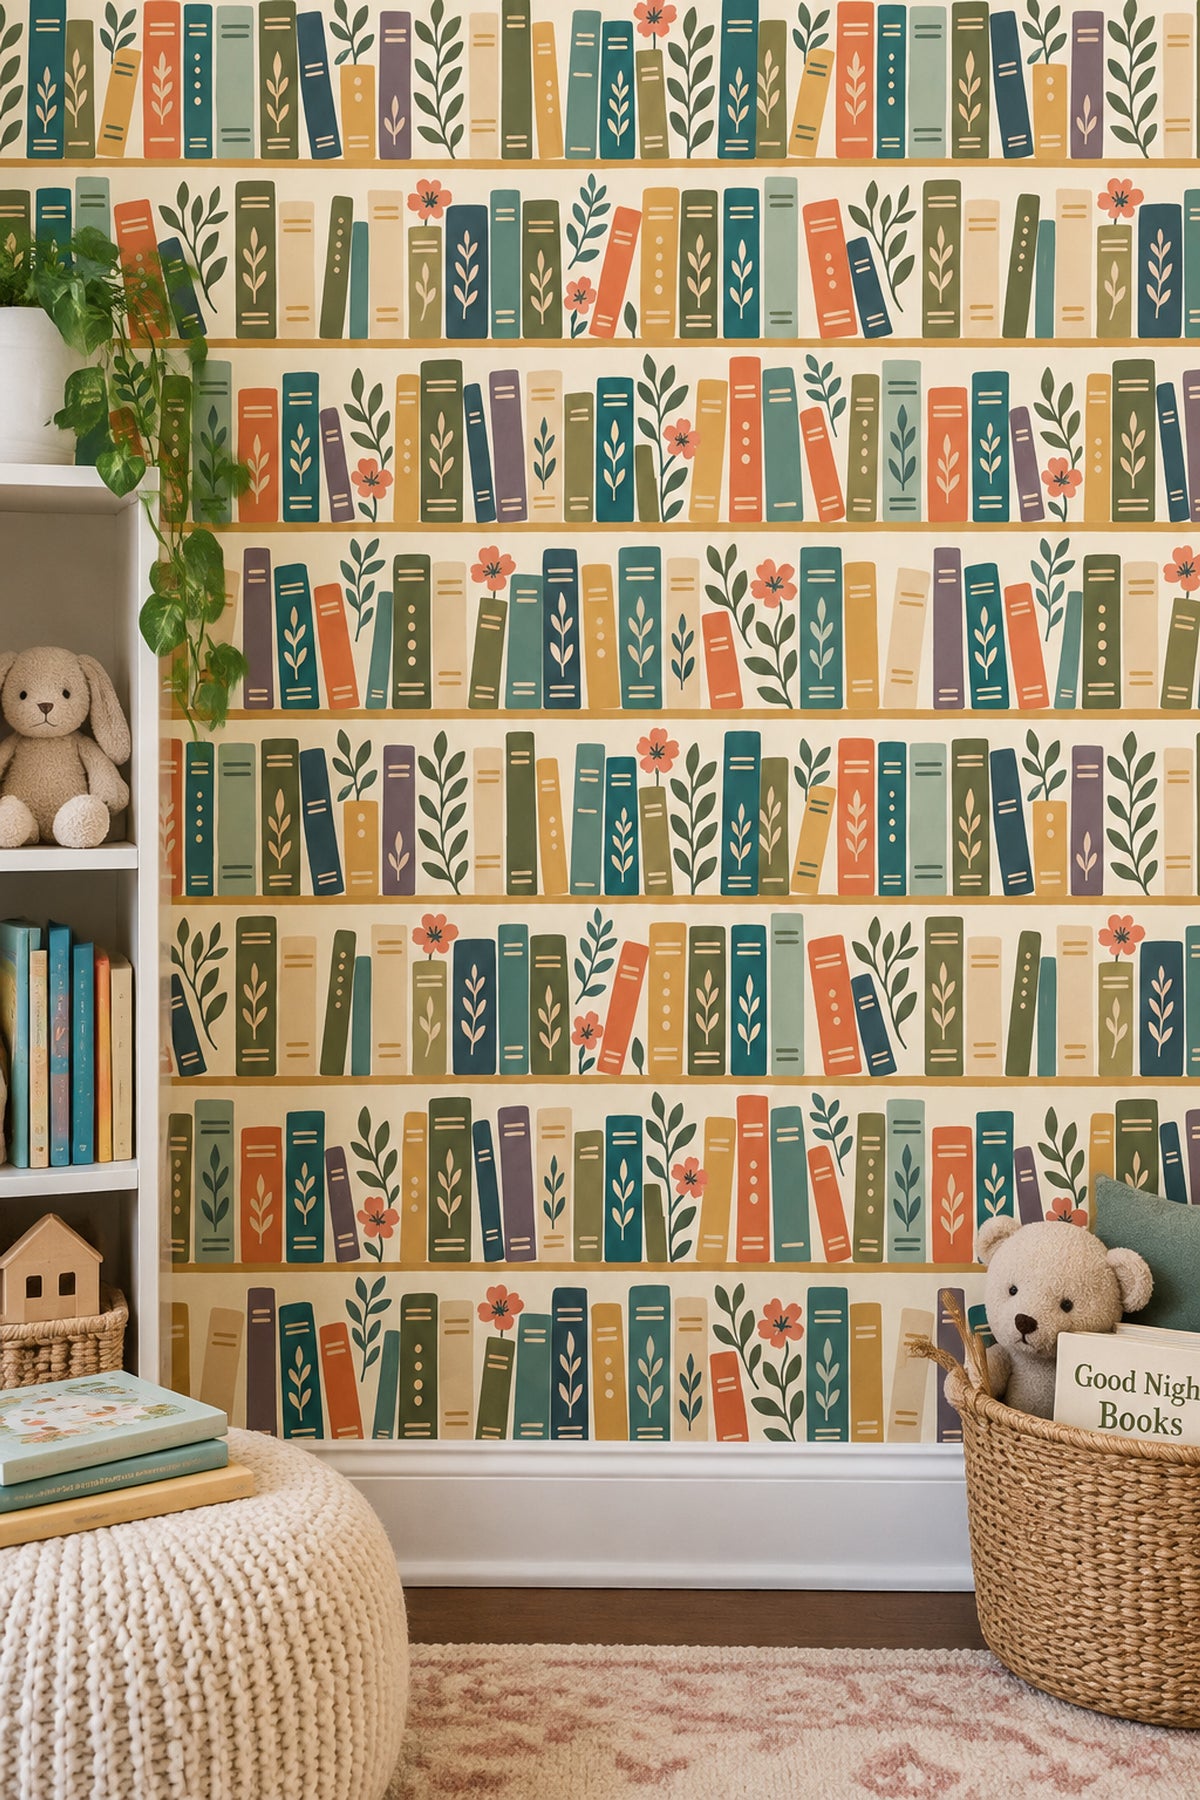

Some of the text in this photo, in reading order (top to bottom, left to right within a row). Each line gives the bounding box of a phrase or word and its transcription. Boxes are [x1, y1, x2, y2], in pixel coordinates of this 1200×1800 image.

[1074, 1363, 1200, 1407] Good Nigh
[1097, 1400, 1183, 1436] Books
